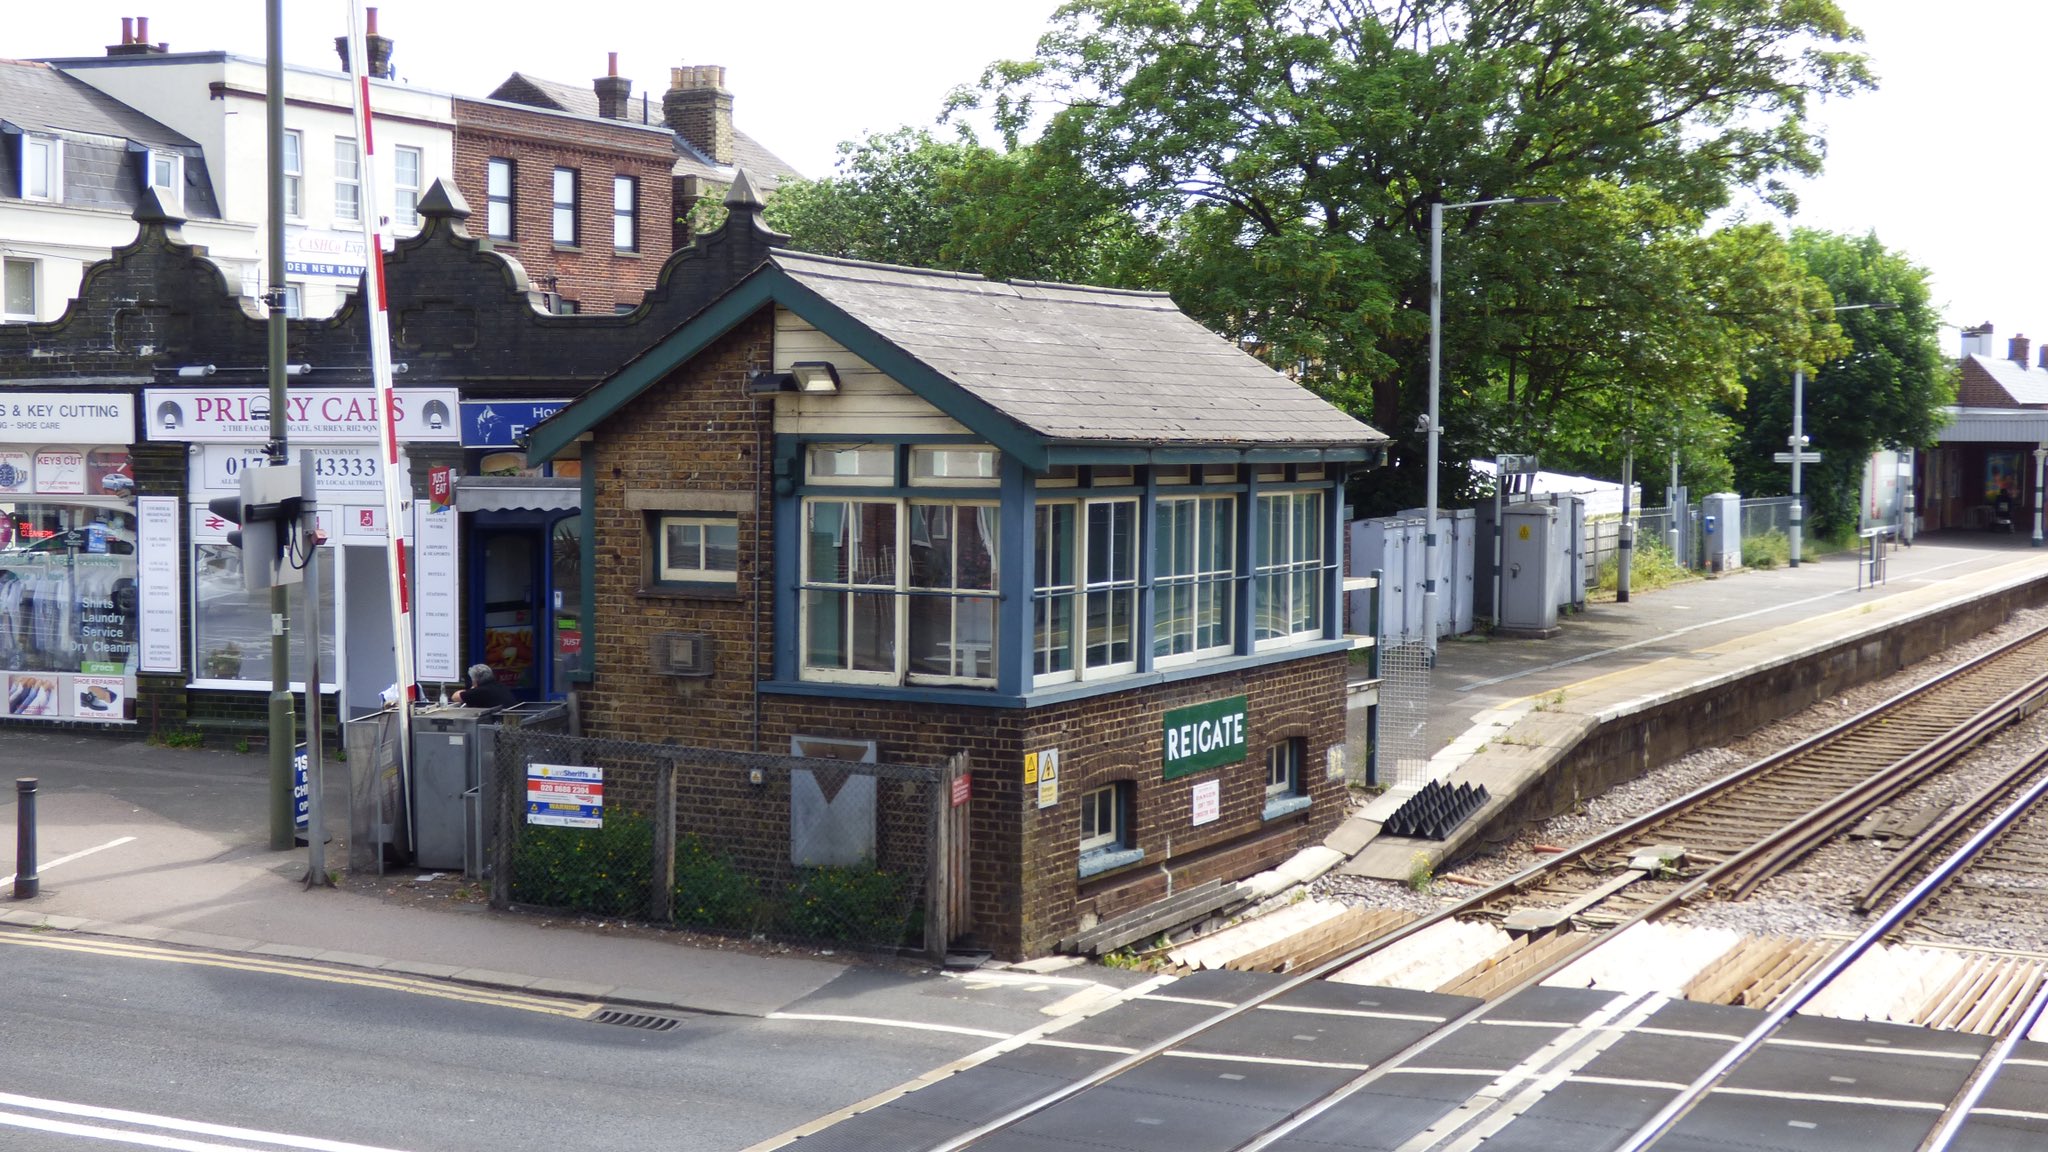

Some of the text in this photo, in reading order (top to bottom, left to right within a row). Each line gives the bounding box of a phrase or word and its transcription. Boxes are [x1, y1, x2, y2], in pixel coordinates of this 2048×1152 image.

[287, 262, 307, 273] DER
[312, 264, 334, 274] NEW
[12, 405, 21, 417] &
[27, 405, 53, 417] KEY
[59, 405, 119, 418] CUTTING
[17, 422, 37, 430] SHOE
[40, 422, 60, 430] CARE
[37, 457, 82, 465] KEYS CUT
[315, 458, 376, 476] 43333
[432, 472, 447, 486] JUST
[435, 483, 447, 495] EAT
[82, 597, 114, 609] Shirts
[82, 612, 125, 625] Laundry
[82, 626, 124, 637] Service
[92, 641, 134, 653] Cleanin
[563, 639, 581, 647] JUST
[90, 664, 114, 672] crocs
[1168, 713, 1244, 761] REIGATE
[302, 772, 308, 782] &
[299, 801, 308, 811] OP
